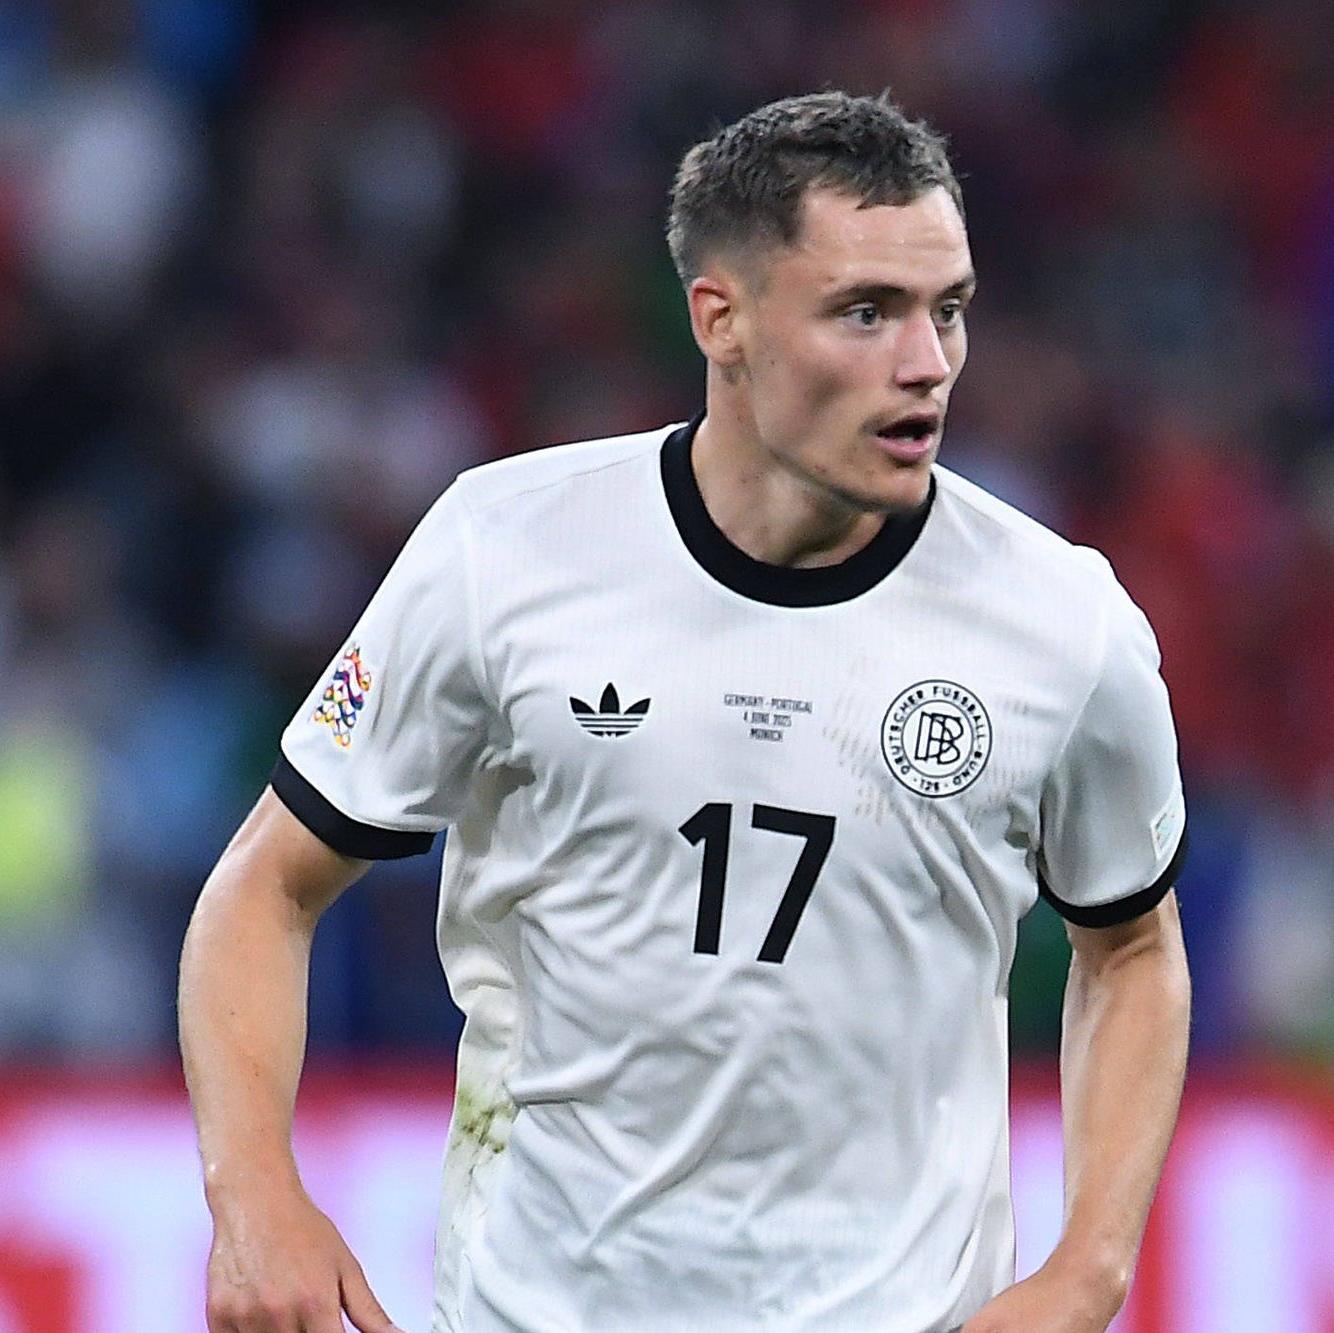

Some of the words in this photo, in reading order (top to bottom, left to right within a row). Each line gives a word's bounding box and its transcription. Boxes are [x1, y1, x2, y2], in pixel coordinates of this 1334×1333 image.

[723, 694, 764, 708] GERMANY
[771, 697, 813, 714] PORTUGAL
[888, 690, 924, 775] DEUTSCHER
[678, 802, 837, 965] 17
